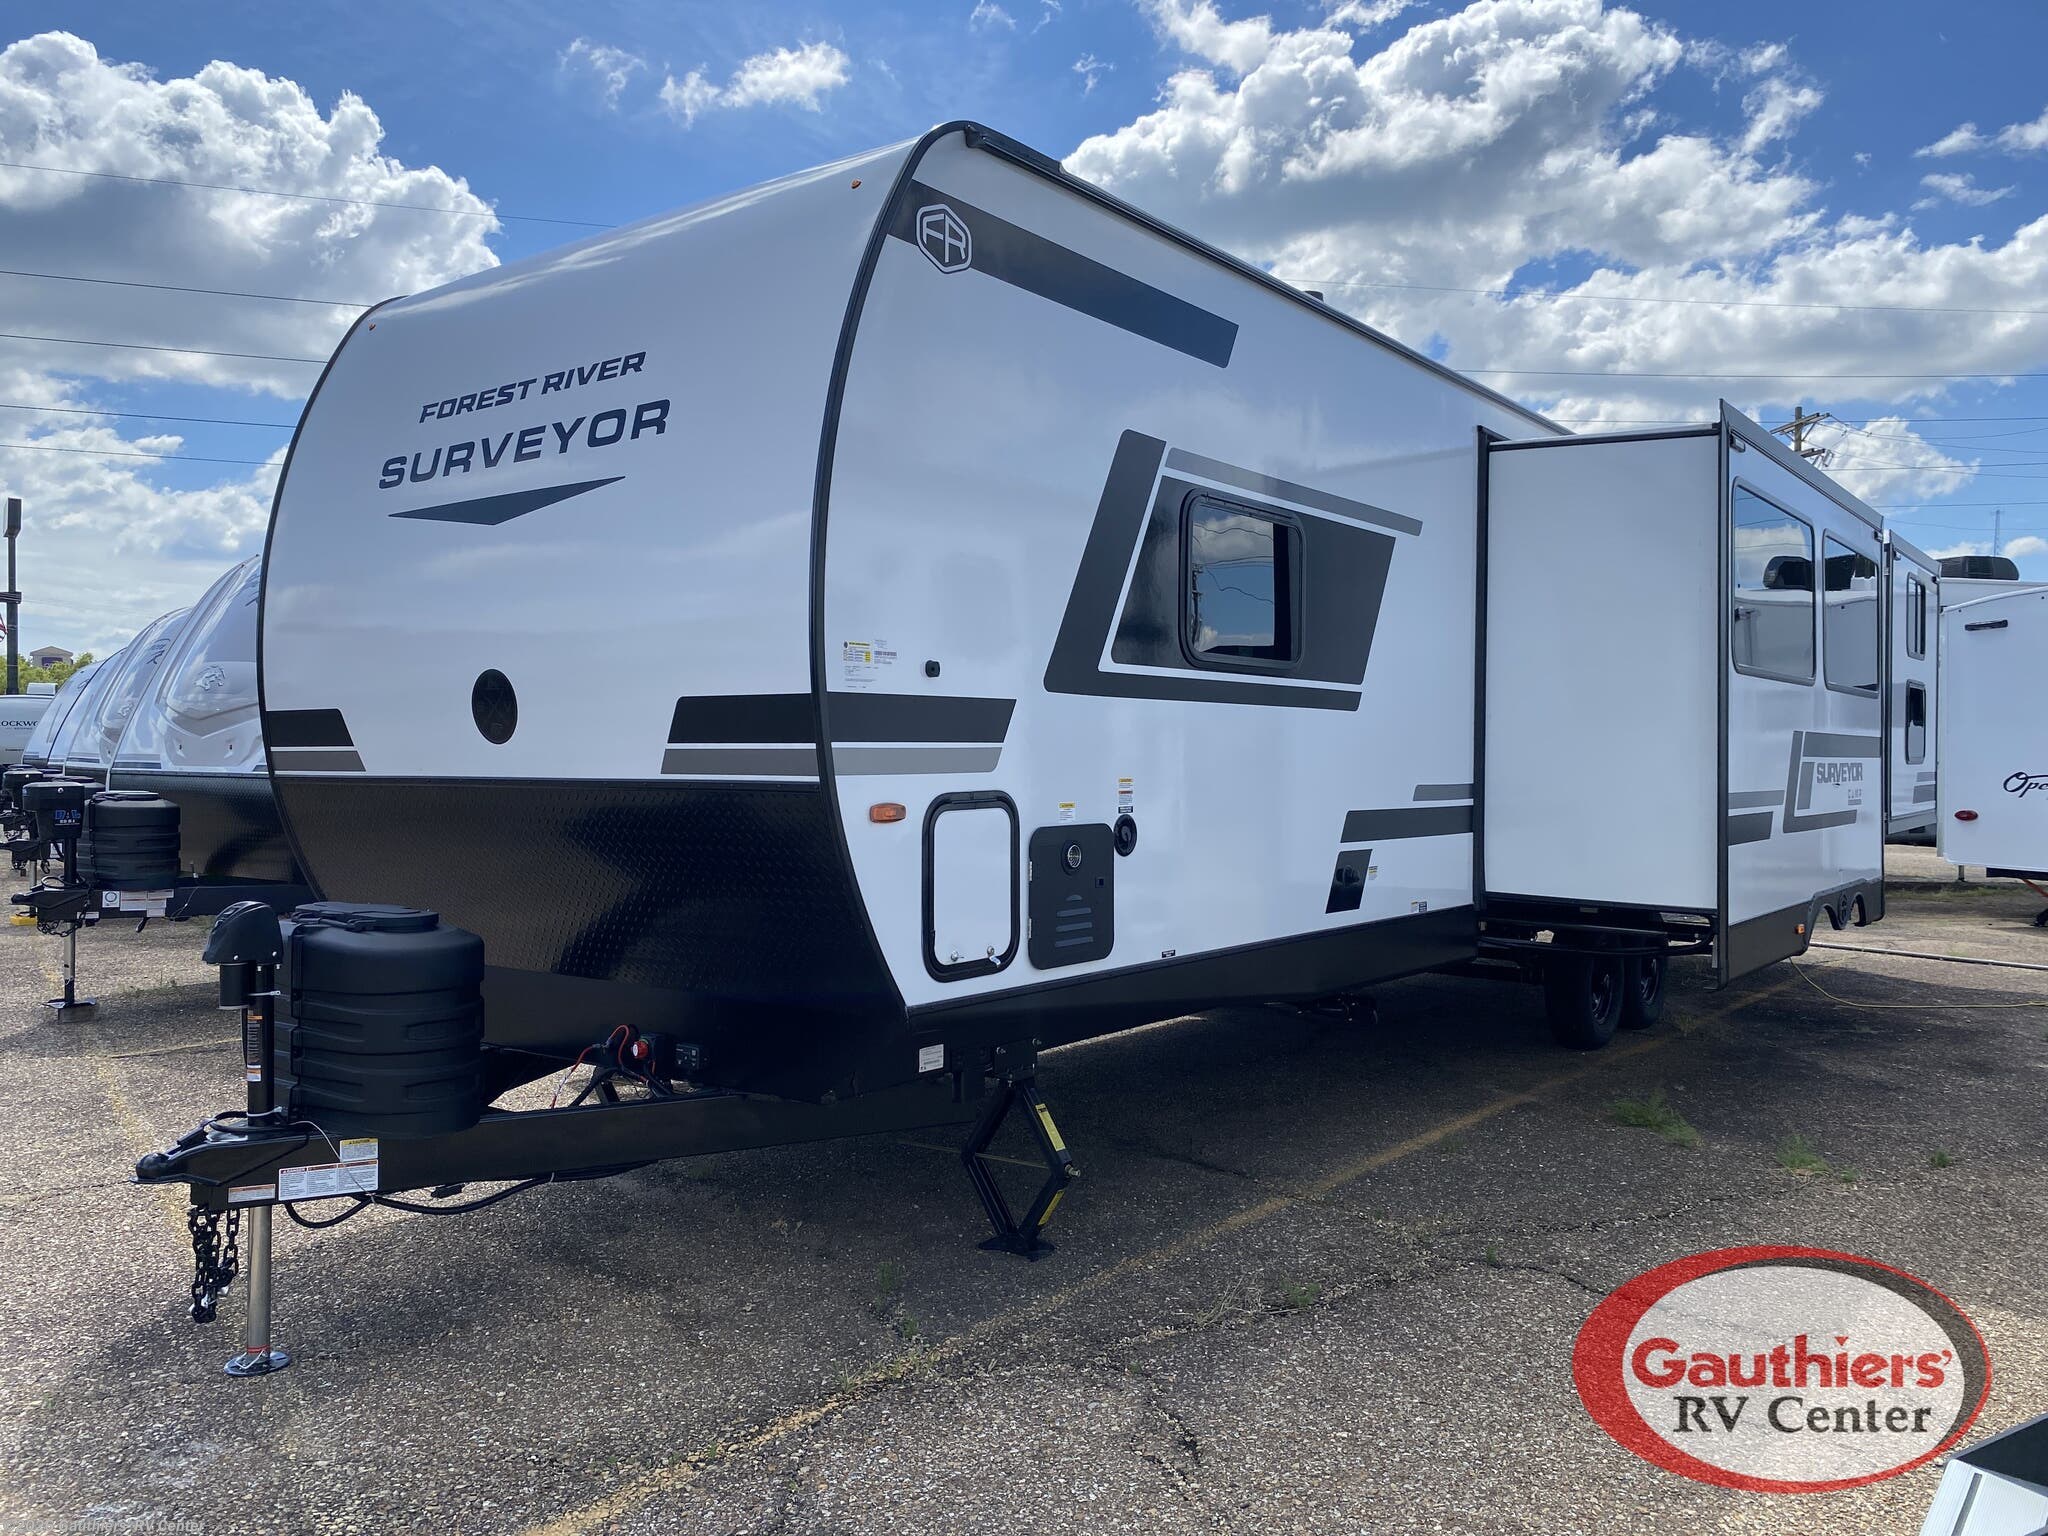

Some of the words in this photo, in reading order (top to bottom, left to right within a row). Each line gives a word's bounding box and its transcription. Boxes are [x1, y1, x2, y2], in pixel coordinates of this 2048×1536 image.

[419, 378, 537, 423] FOREST
[541, 351, 646, 395] RIVER
[379, 399, 670, 489] SURVEYOR
[1816, 762, 1863, 784] SURVEYOR
